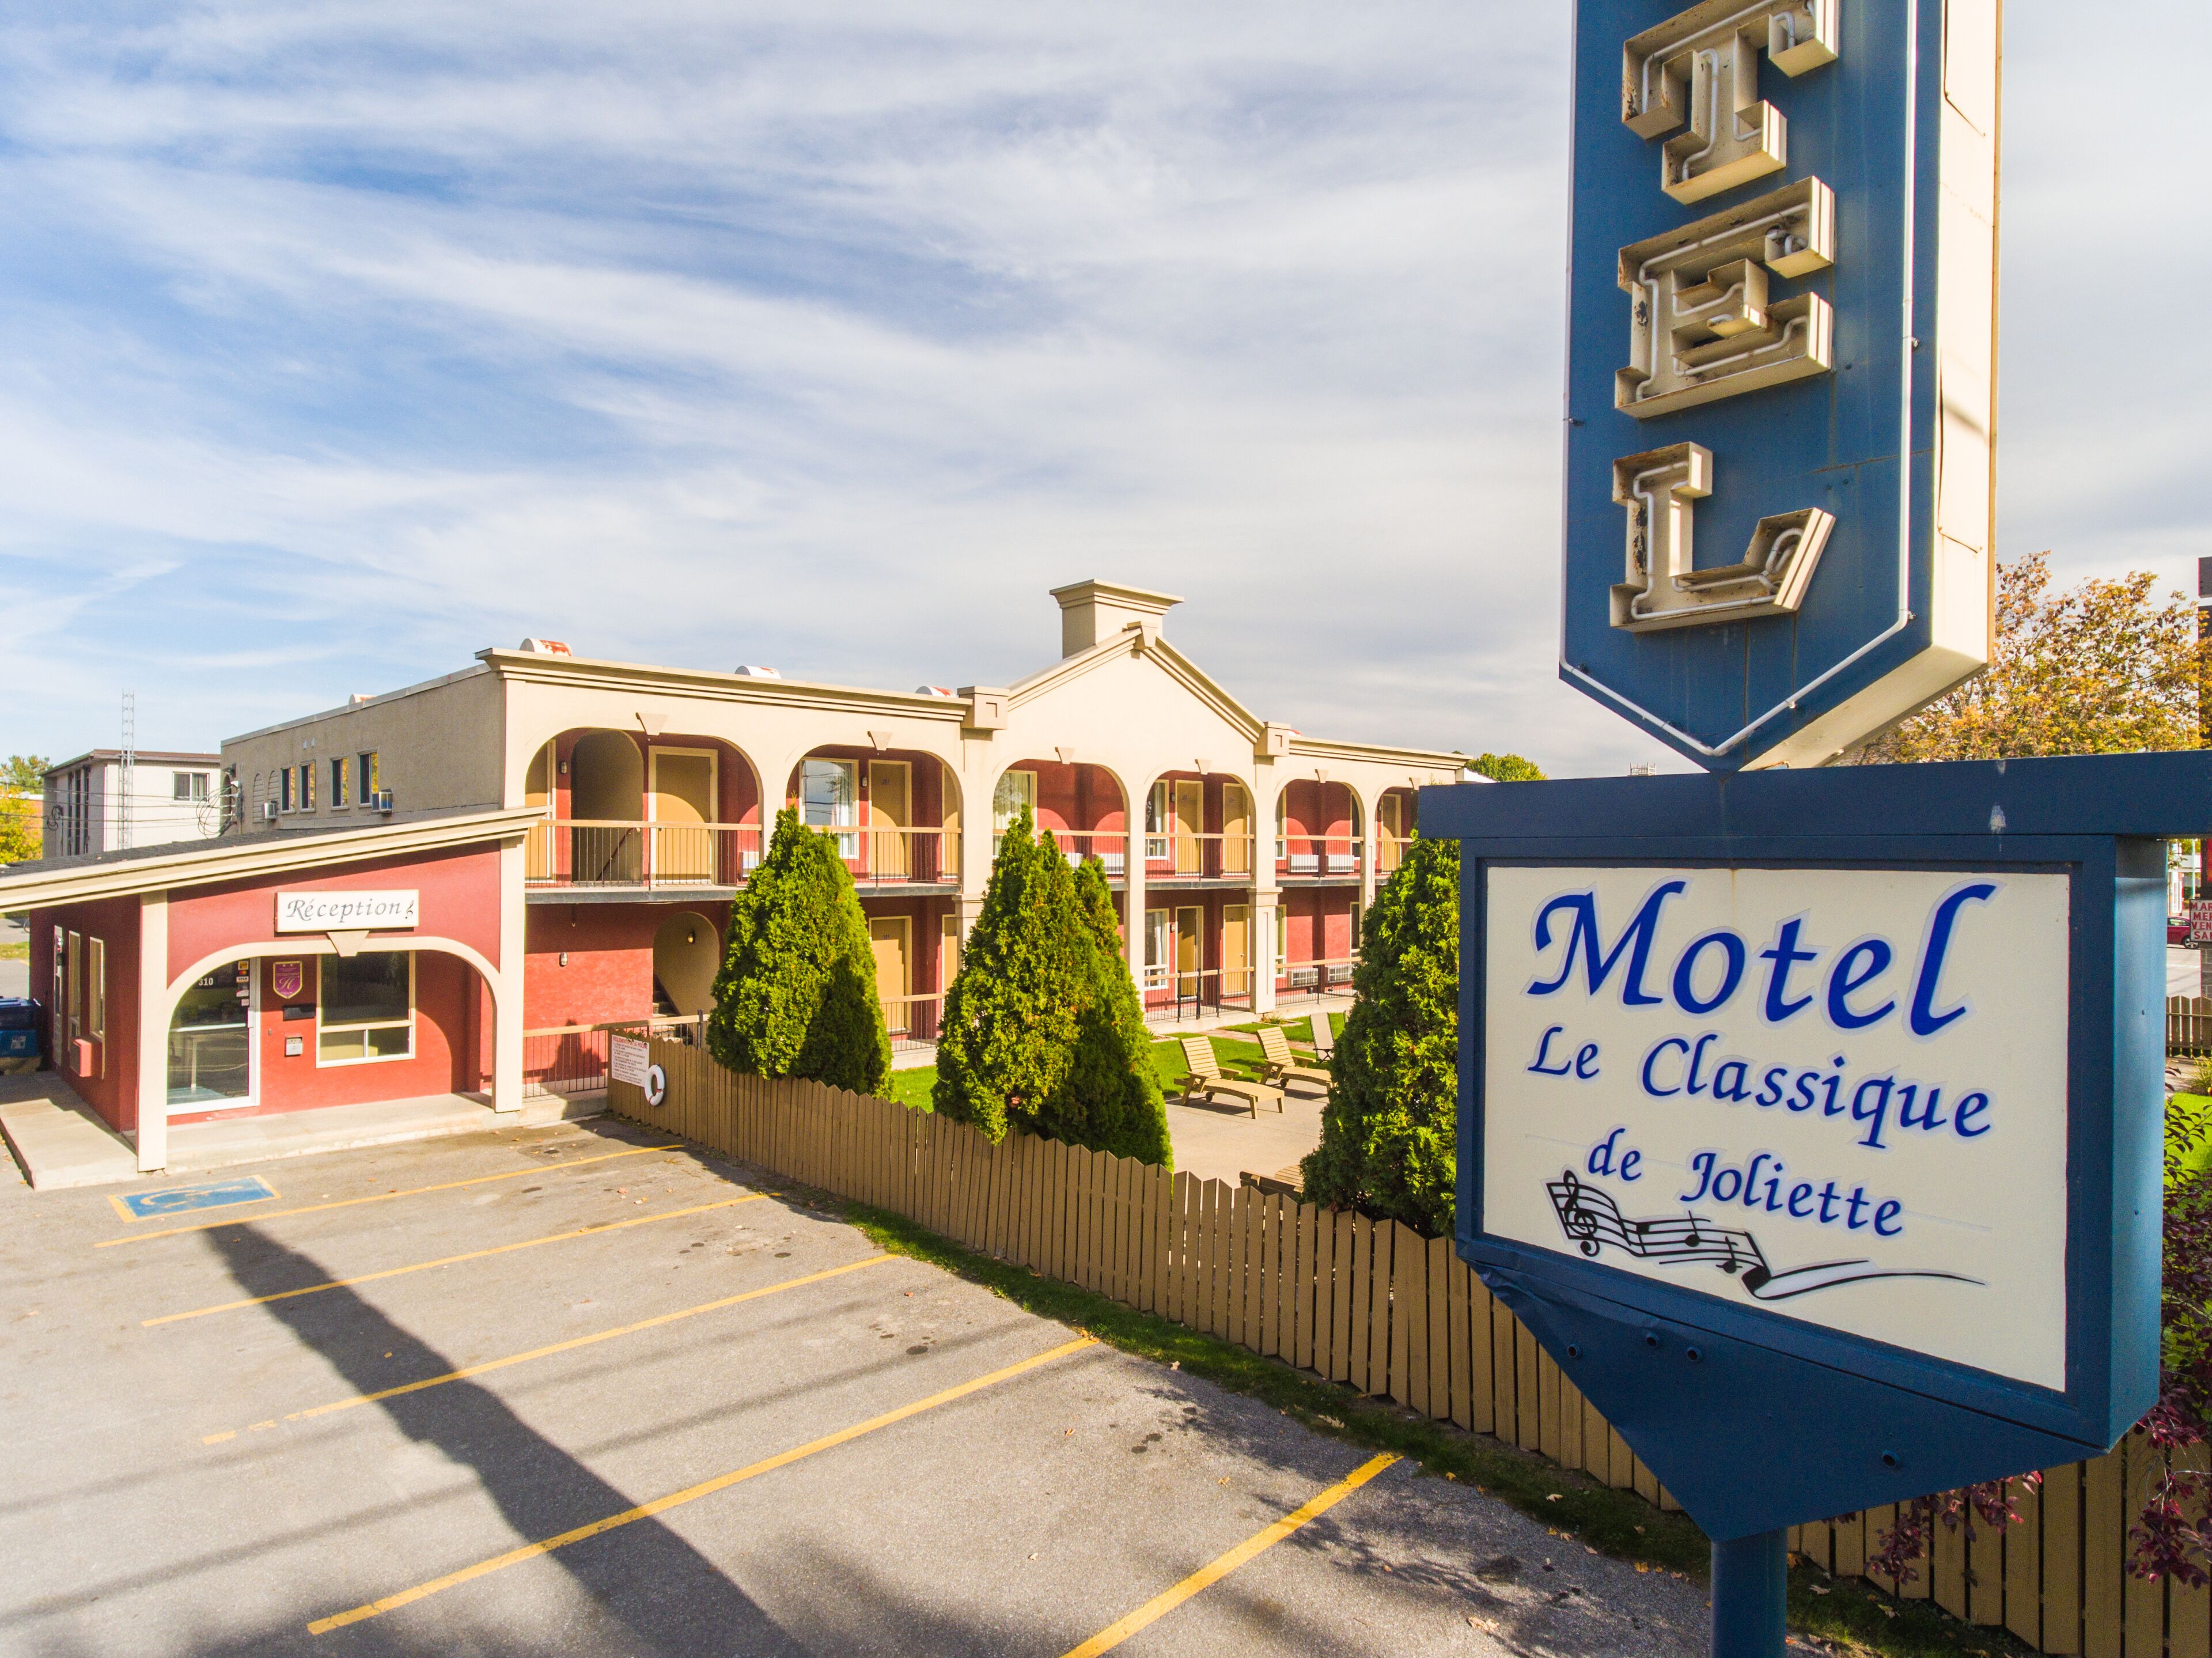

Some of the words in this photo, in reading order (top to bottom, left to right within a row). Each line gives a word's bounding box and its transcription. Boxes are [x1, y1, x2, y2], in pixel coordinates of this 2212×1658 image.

[286, 898, 402, 923] Réception
[1528, 881, 1997, 1036] Motel
[199, 977, 214, 986] 310
[1528, 1025, 1600, 1080] Le
[1642, 1033, 1991, 1148] Classique
[1588, 1127, 1643, 1182] de
[1681, 1152, 1903, 1236] Joliette
